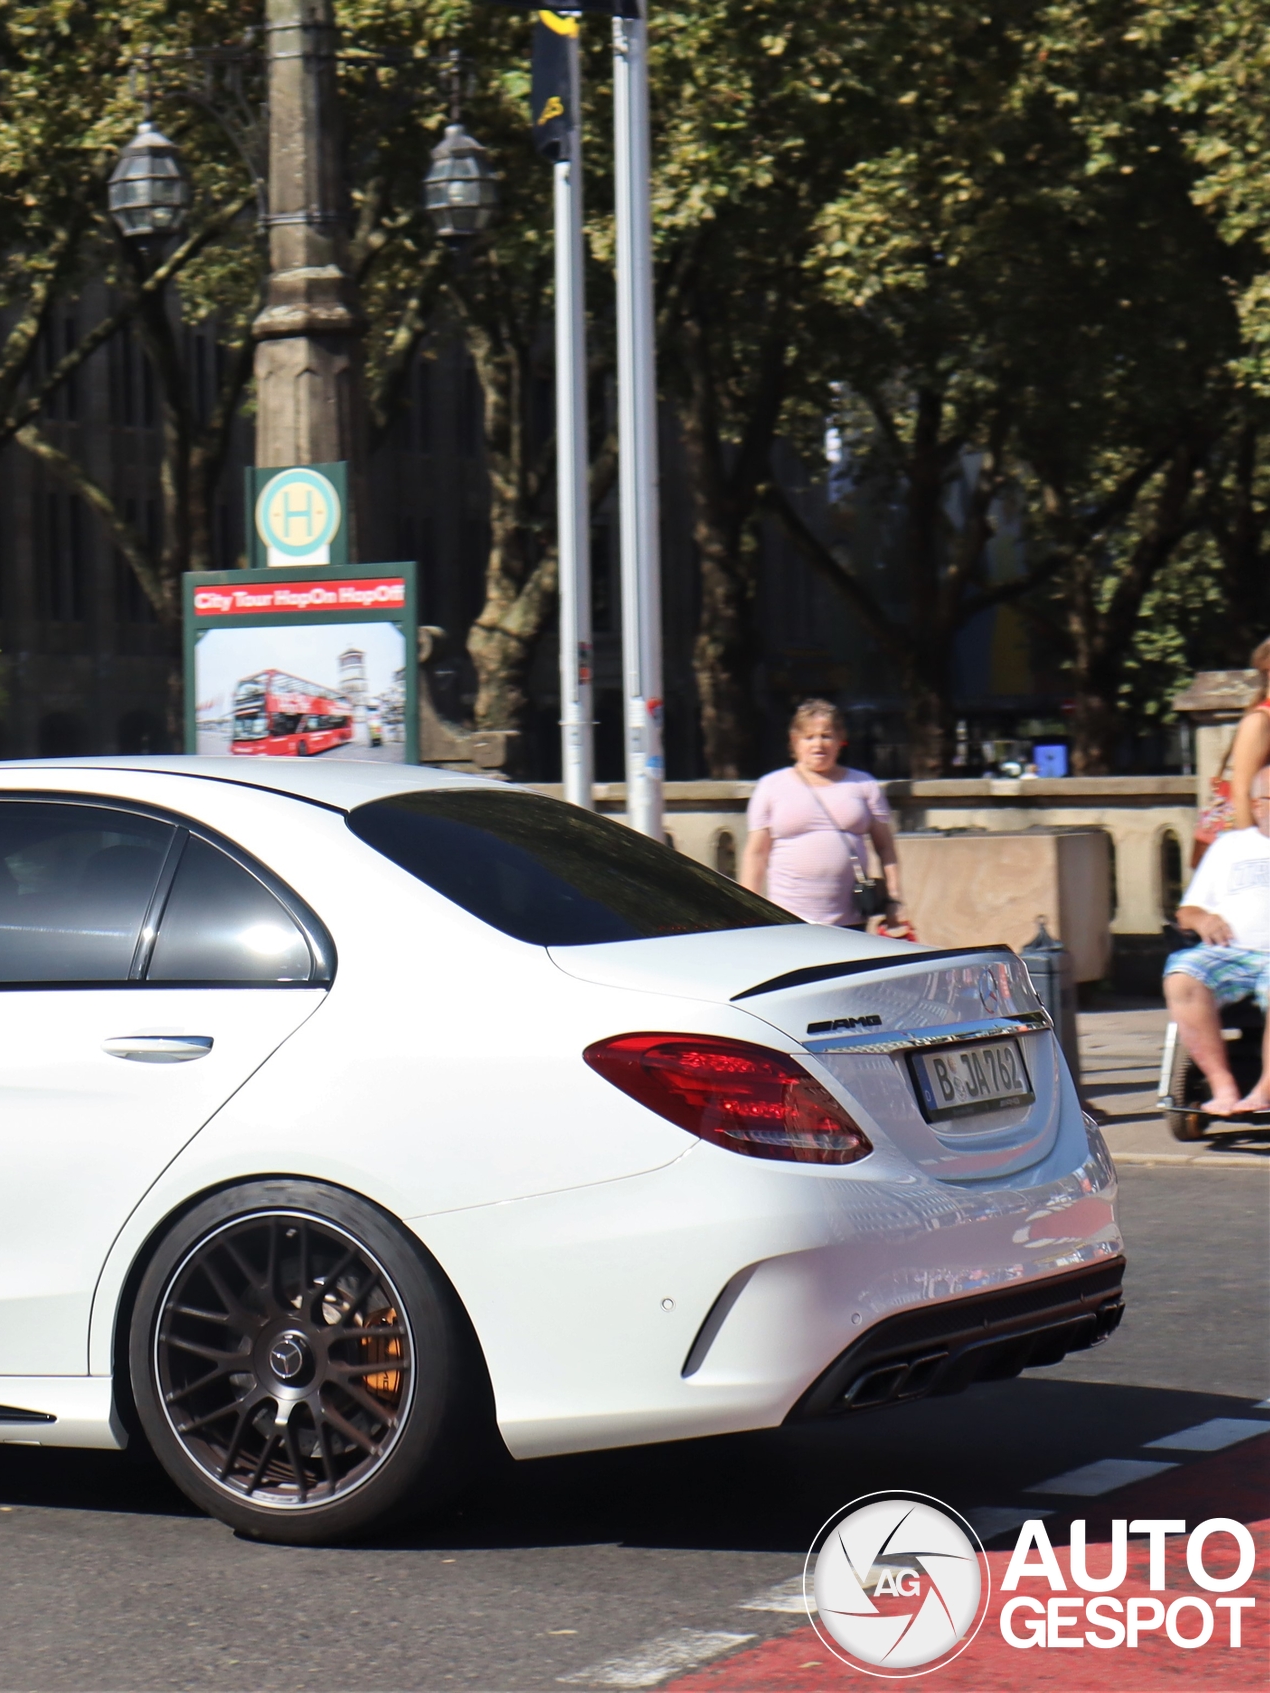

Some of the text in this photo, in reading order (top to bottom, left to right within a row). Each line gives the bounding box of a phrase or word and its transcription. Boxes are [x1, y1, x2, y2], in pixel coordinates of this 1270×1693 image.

[282, 490, 314, 538] H
[194, 591, 233, 612] City
[233, 591, 273, 608] Tour
[831, 1014, 882, 1031] AMG
[933, 1058, 955, 1102] B
[983, 1047, 1023, 1092] 762
